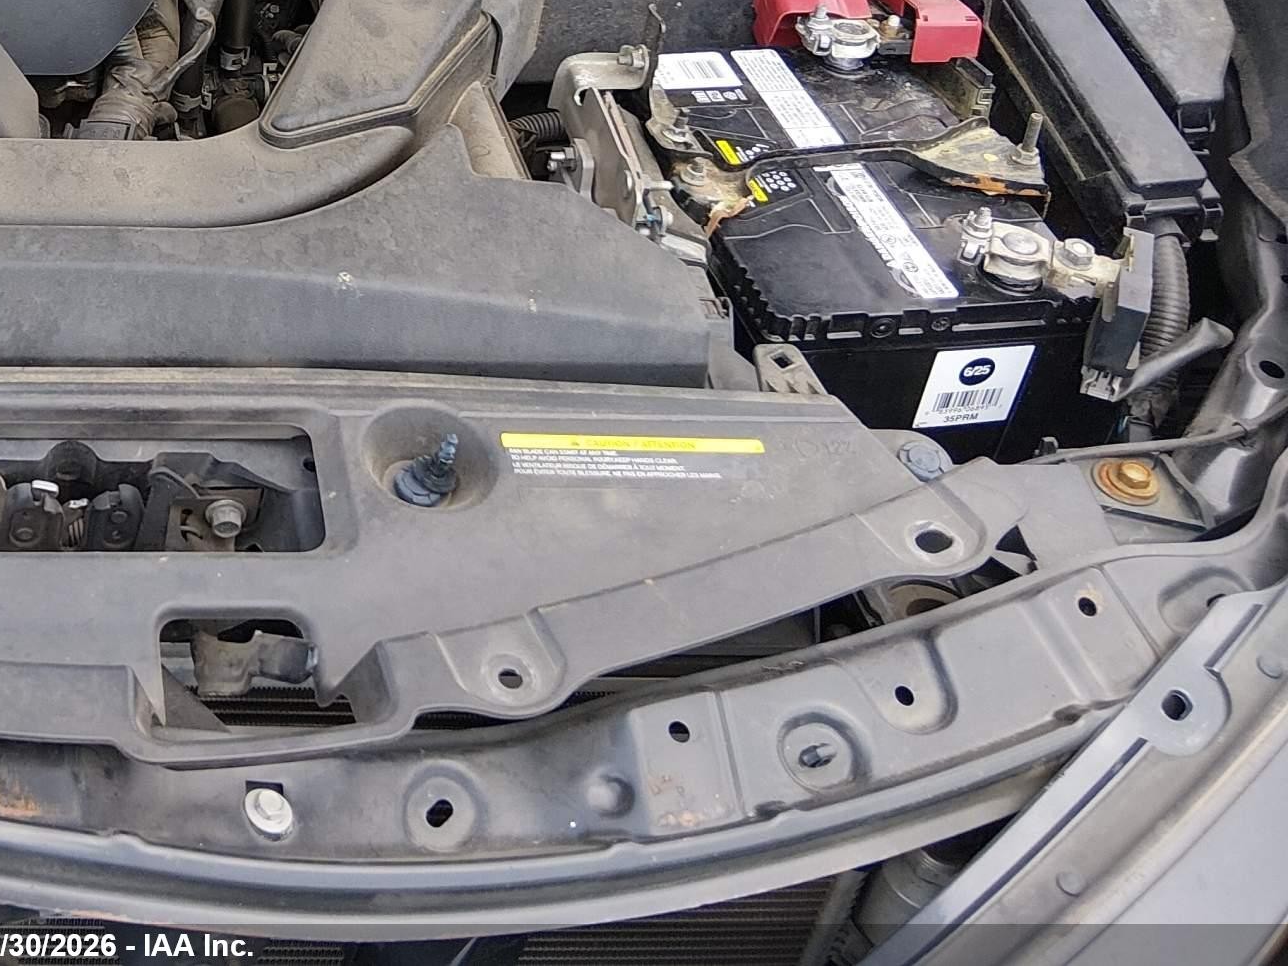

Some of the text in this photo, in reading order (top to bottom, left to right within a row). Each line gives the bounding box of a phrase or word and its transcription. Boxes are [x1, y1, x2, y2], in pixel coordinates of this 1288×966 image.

[963, 364, 992, 377] 6/25
[943, 412, 979, 424] 35PRM
[641, 440, 697, 449] ATTENTION
